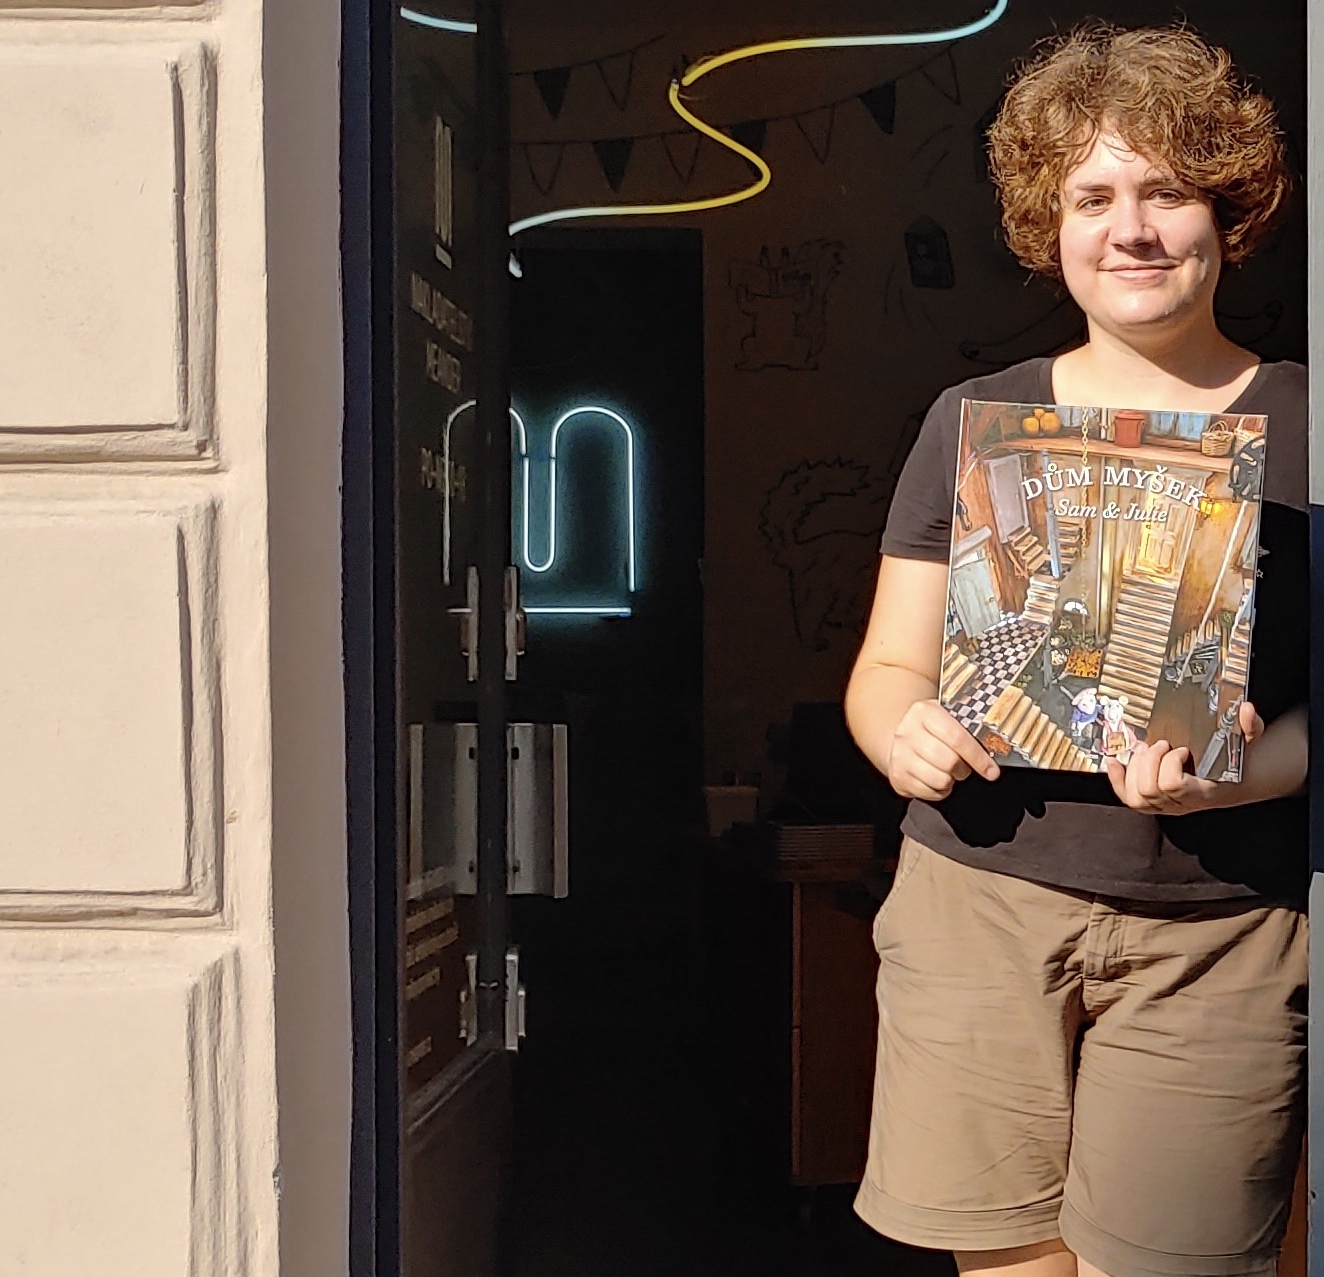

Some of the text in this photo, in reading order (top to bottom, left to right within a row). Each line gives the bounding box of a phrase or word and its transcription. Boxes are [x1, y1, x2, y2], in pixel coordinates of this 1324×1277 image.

[1020, 462, 1212, 512] DŮM MYŠEK
[1053, 498, 1169, 523] Sam & Julie
